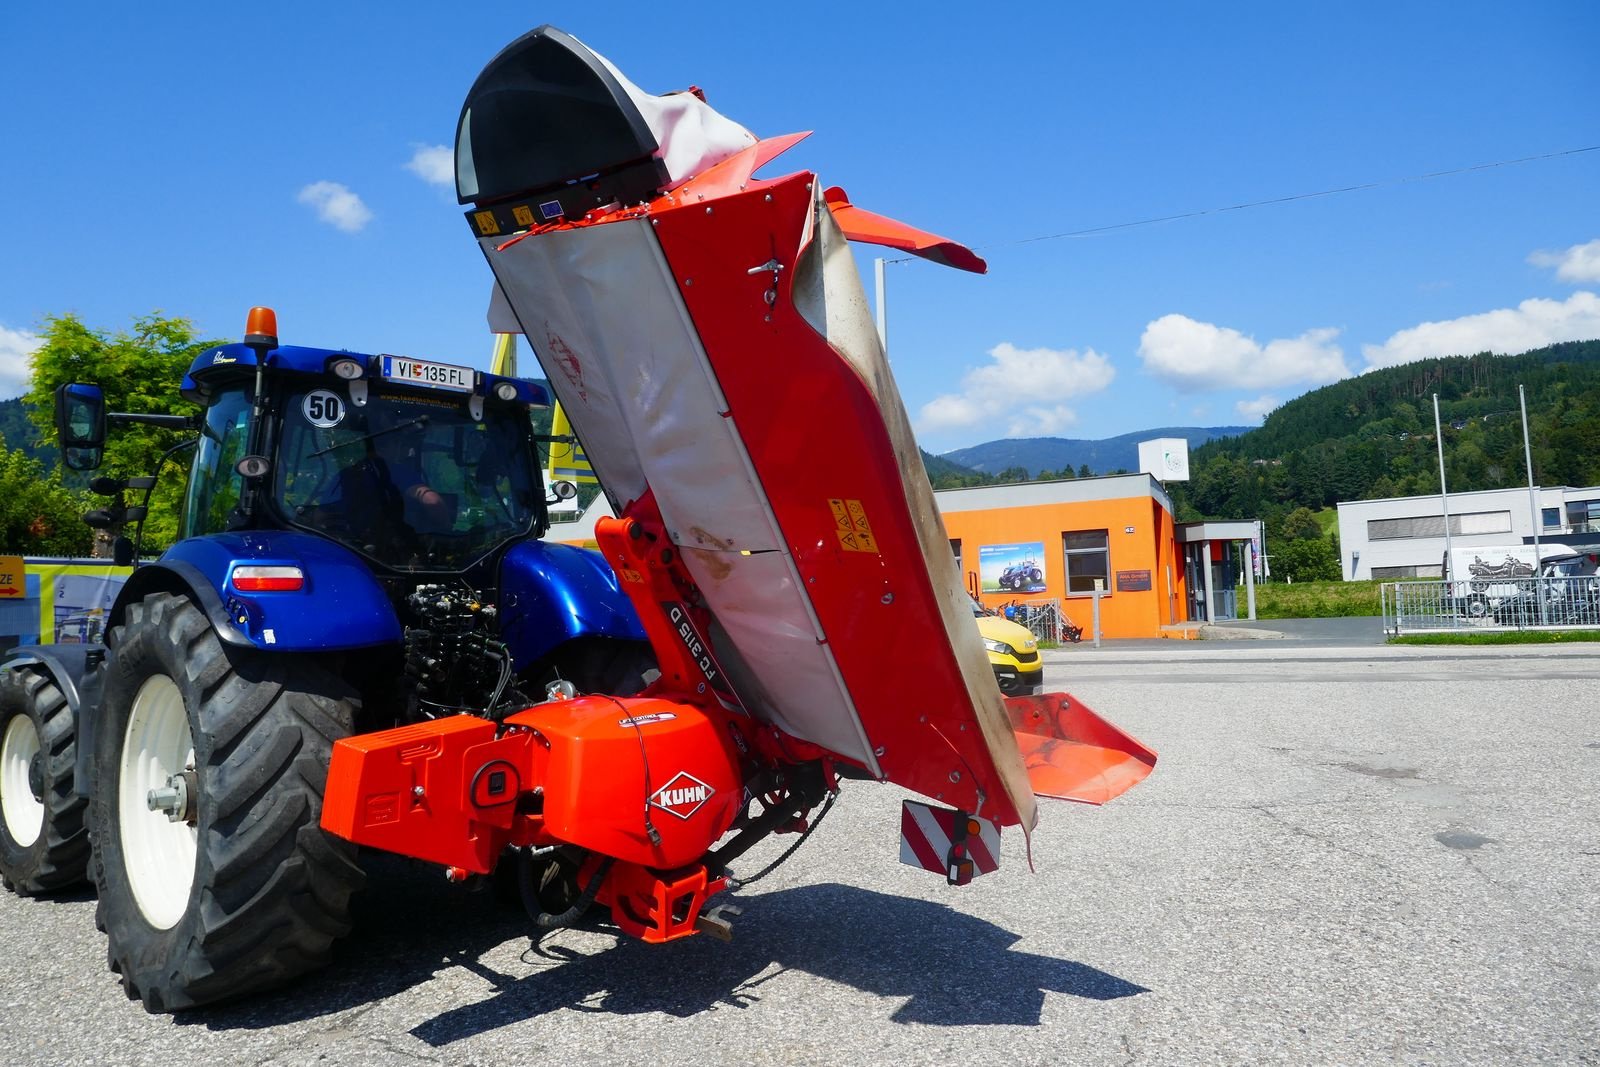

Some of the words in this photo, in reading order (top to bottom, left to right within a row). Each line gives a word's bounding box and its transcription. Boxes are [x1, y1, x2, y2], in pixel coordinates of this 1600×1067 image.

[398, 361, 412, 378] VI
[423, 366, 447, 382] 135
[449, 370, 465, 386] FL
[309, 395, 339, 422] 50
[670, 607, 682, 623] D
[679, 622, 702, 657] 3115
[699, 656, 716, 681] FC
[660, 785, 706, 807] KUHN
